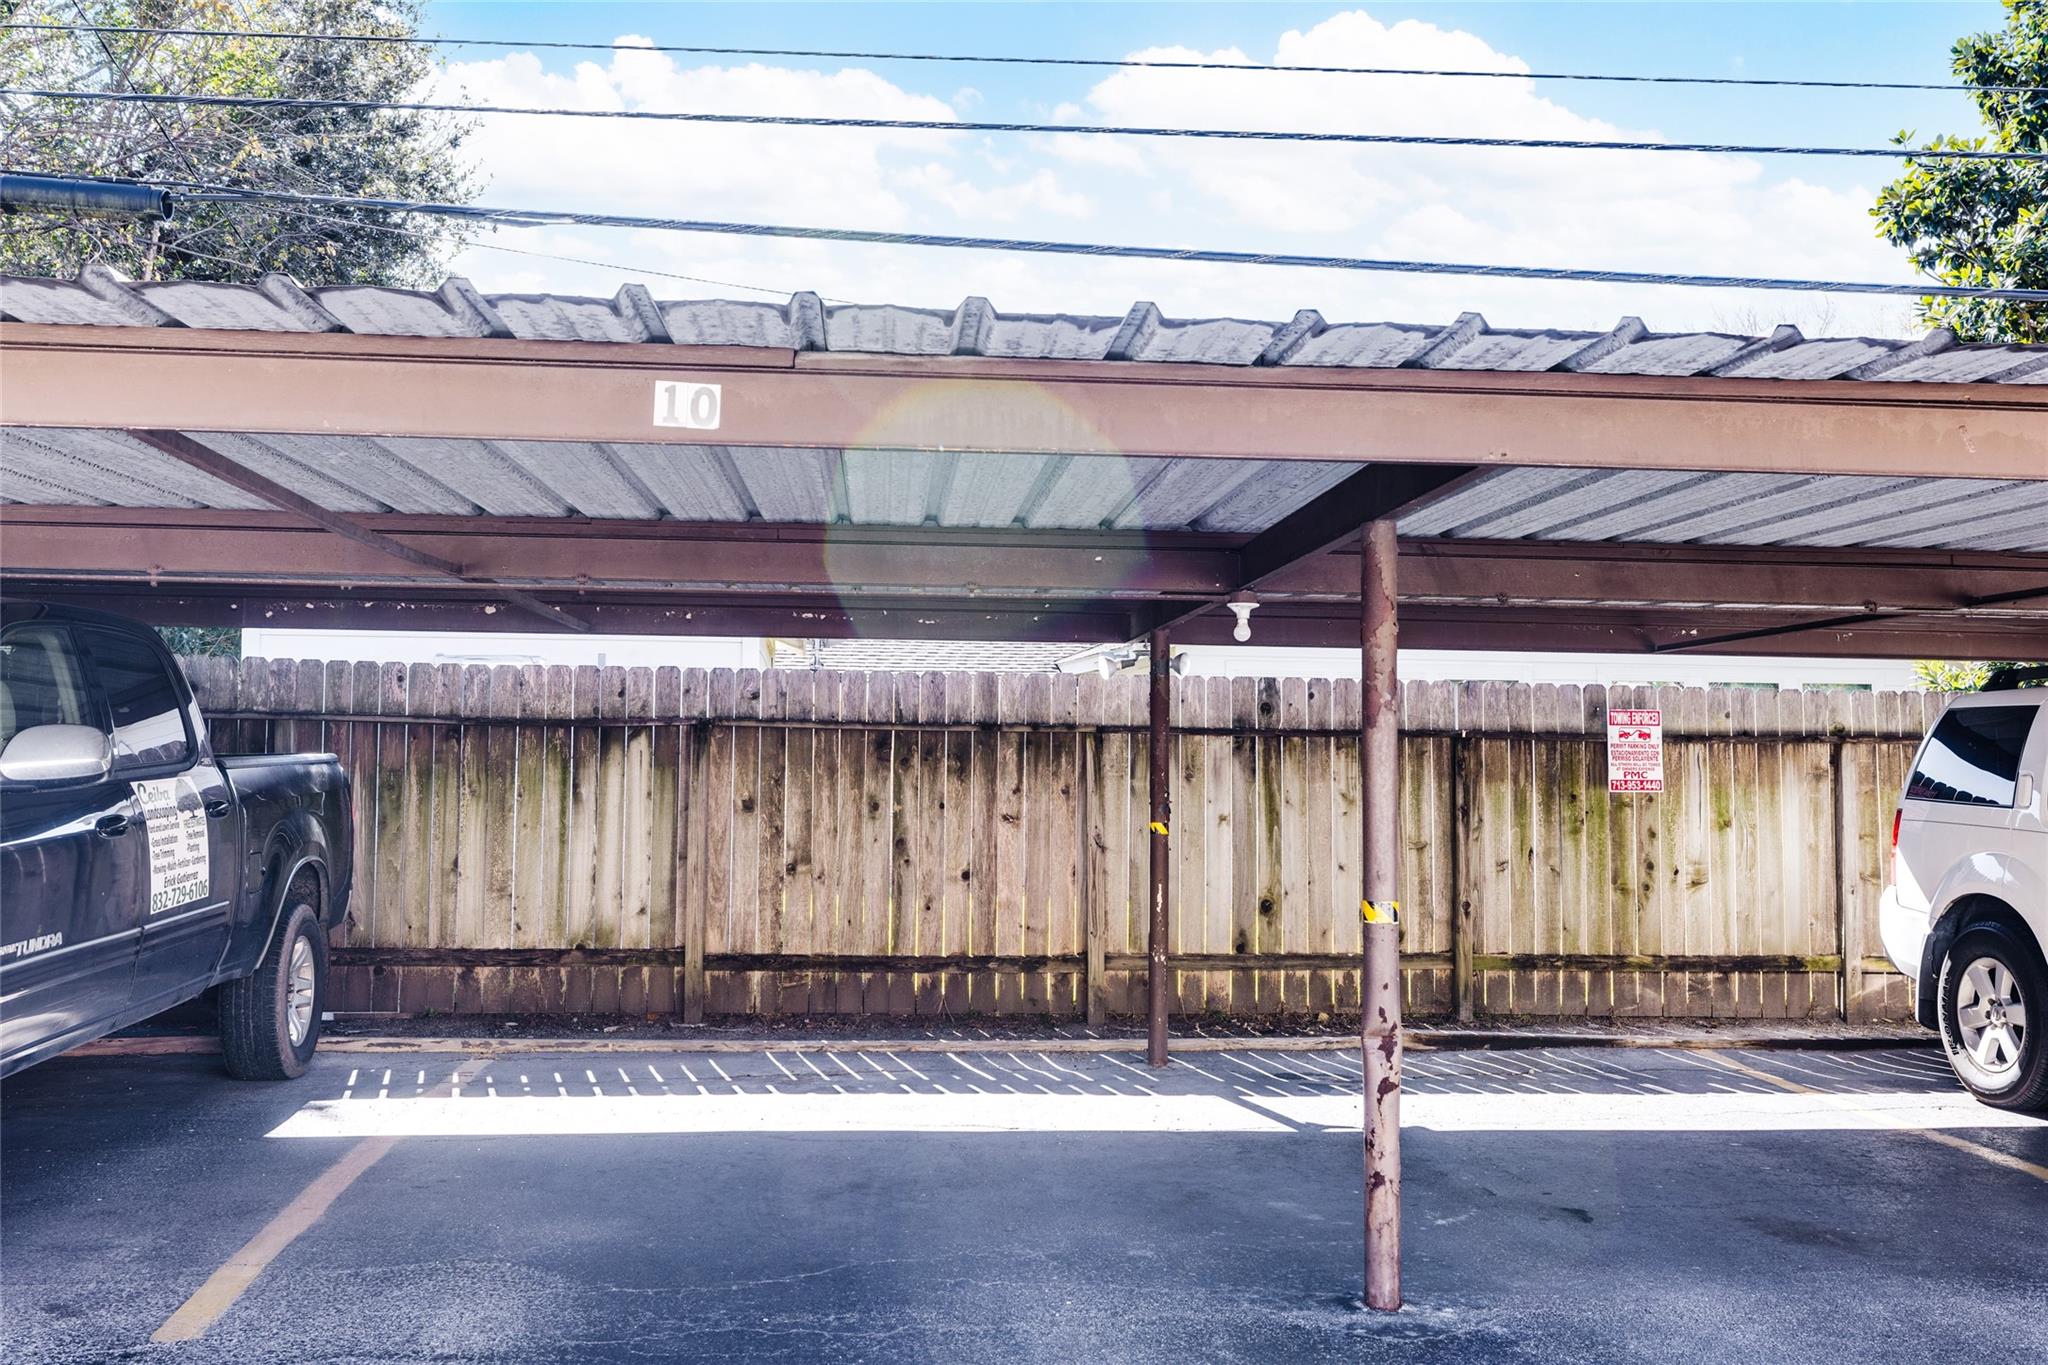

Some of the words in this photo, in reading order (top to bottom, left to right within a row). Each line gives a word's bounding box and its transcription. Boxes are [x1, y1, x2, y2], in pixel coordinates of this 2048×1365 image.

[662, 384, 718, 427] 10
[1610, 711, 1631, 725] TOWING
[1632, 711, 1659, 725] ENFORCED
[1623, 771, 1648, 779] PMC
[137, 782, 171, 805] Ceiba
[1611, 780, 1661, 790] 713-953-1440
[145, 804, 178, 821] Landscaping
[164, 874, 176, 888] Erick
[152, 879, 208, 912] 832-729-6106
[16, 931, 63, 957] TUNDRA
